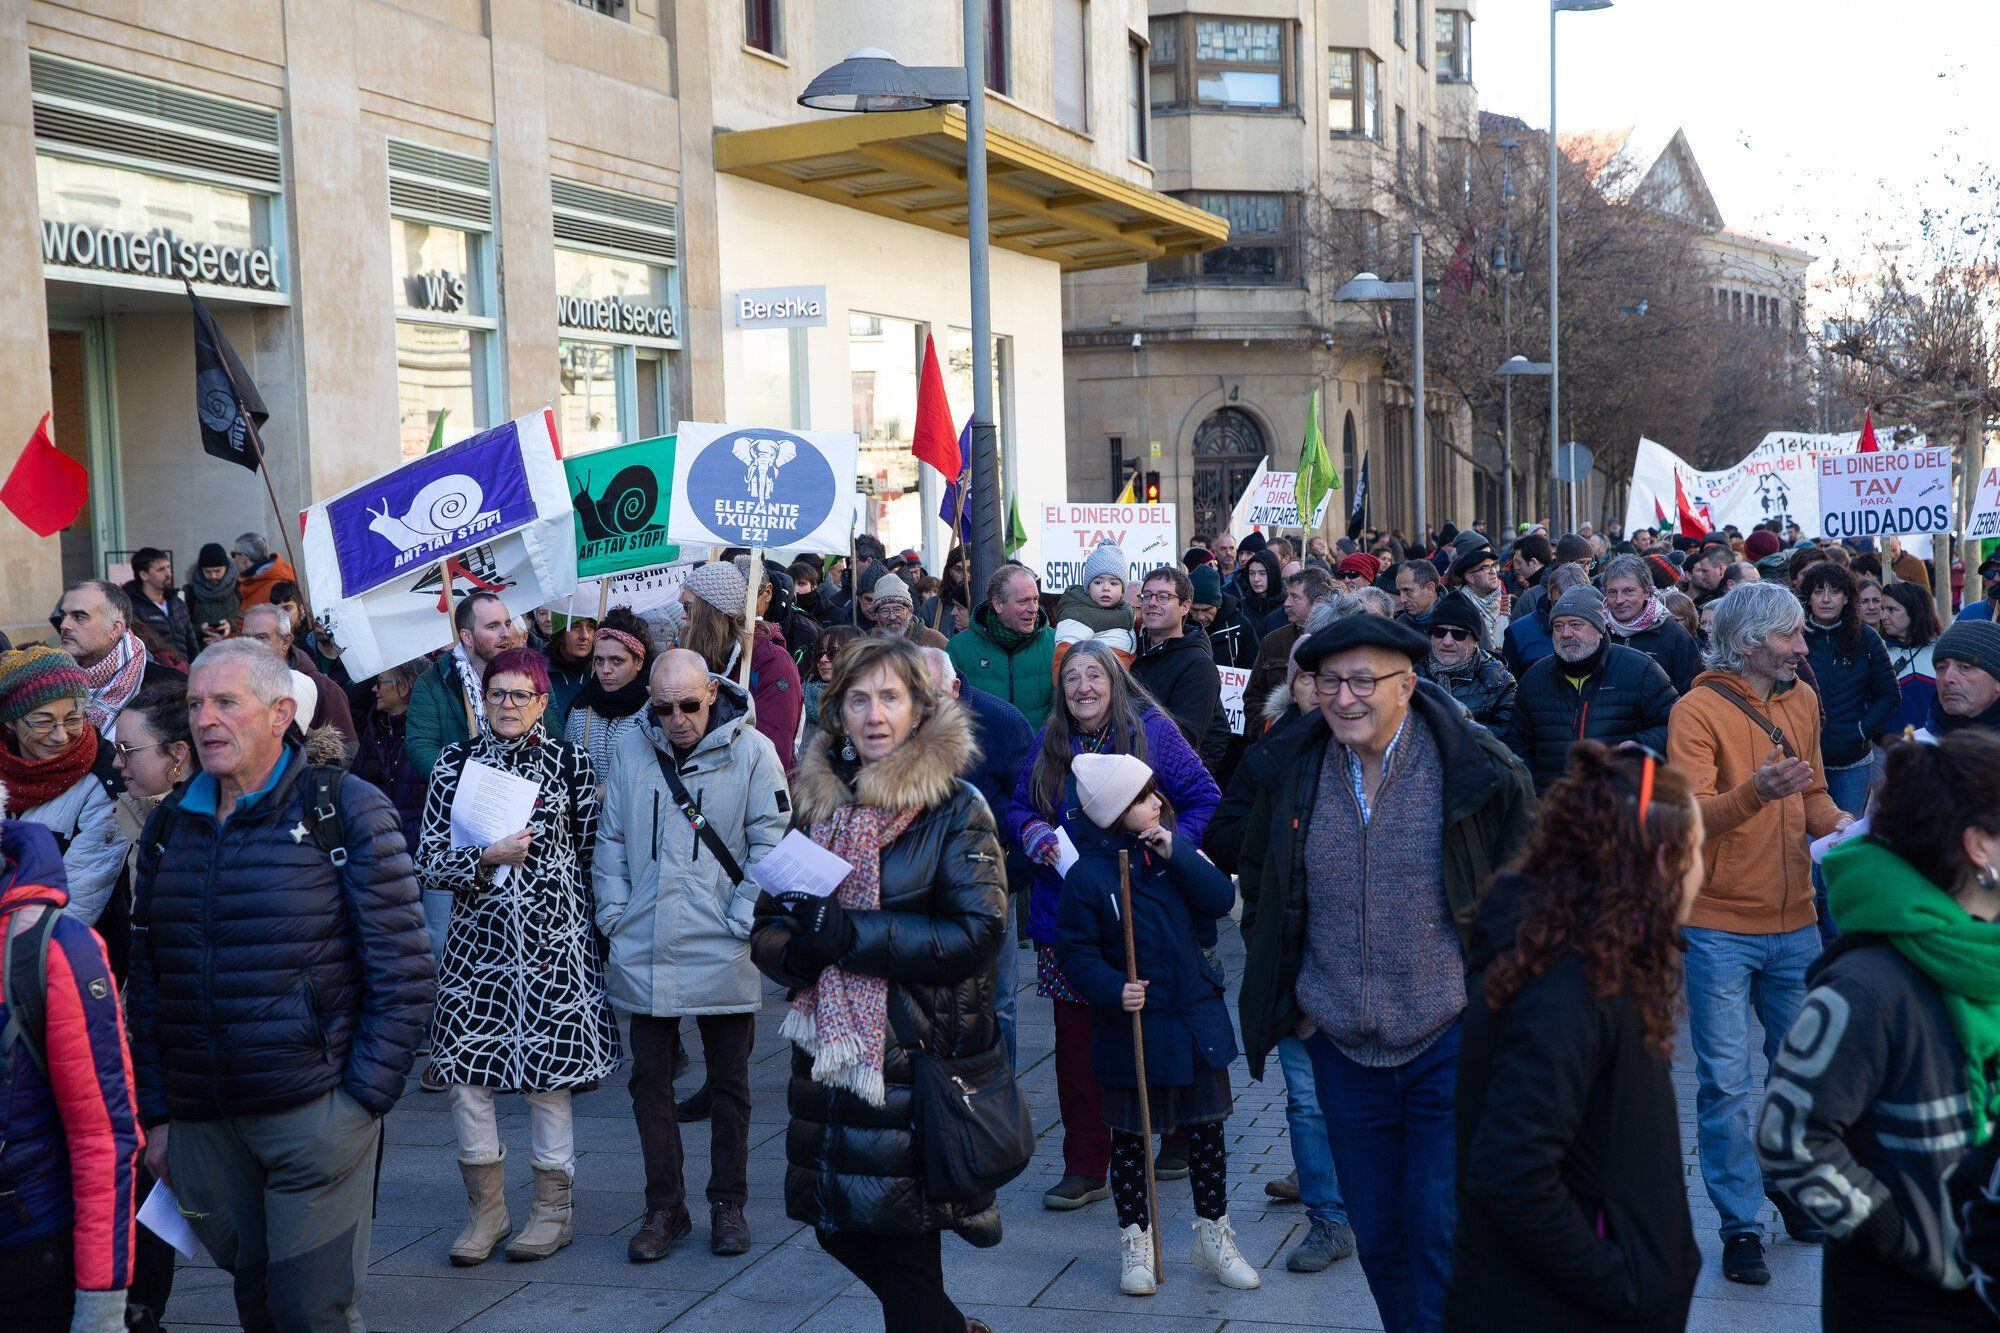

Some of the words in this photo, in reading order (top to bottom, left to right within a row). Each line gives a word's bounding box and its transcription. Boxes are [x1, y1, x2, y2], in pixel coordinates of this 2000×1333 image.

[41, 219, 280, 288] women'secret
[741, 297, 820, 319] Bershka
[1776, 453, 1802, 471] del
[1822, 459, 1843, 477] EL
[1846, 453, 1909, 474] DINERO
[1914, 451, 1947, 468] DEL
[1851, 476, 1903, 497] TAV
[715, 499, 800, 517] ELEFANTE
[1860, 497, 1893, 506] PARA
[716, 513, 798, 530] TXURIRIK
[1046, 507, 1066, 524] EL
[1071, 507, 1134, 524] DINERO
[1139, 507, 1171, 524] DEL
[1824, 504, 1949, 538] CUIDADOS
[394, 532, 453, 568] AHT-TAV
[457, 511, 501, 540] STOP!
[741, 528, 768, 541] EZ!
[1073, 530, 1127, 548] TAV
[578, 536, 627, 560] AHT-TAV
[628, 531, 665, 551] STOP!
